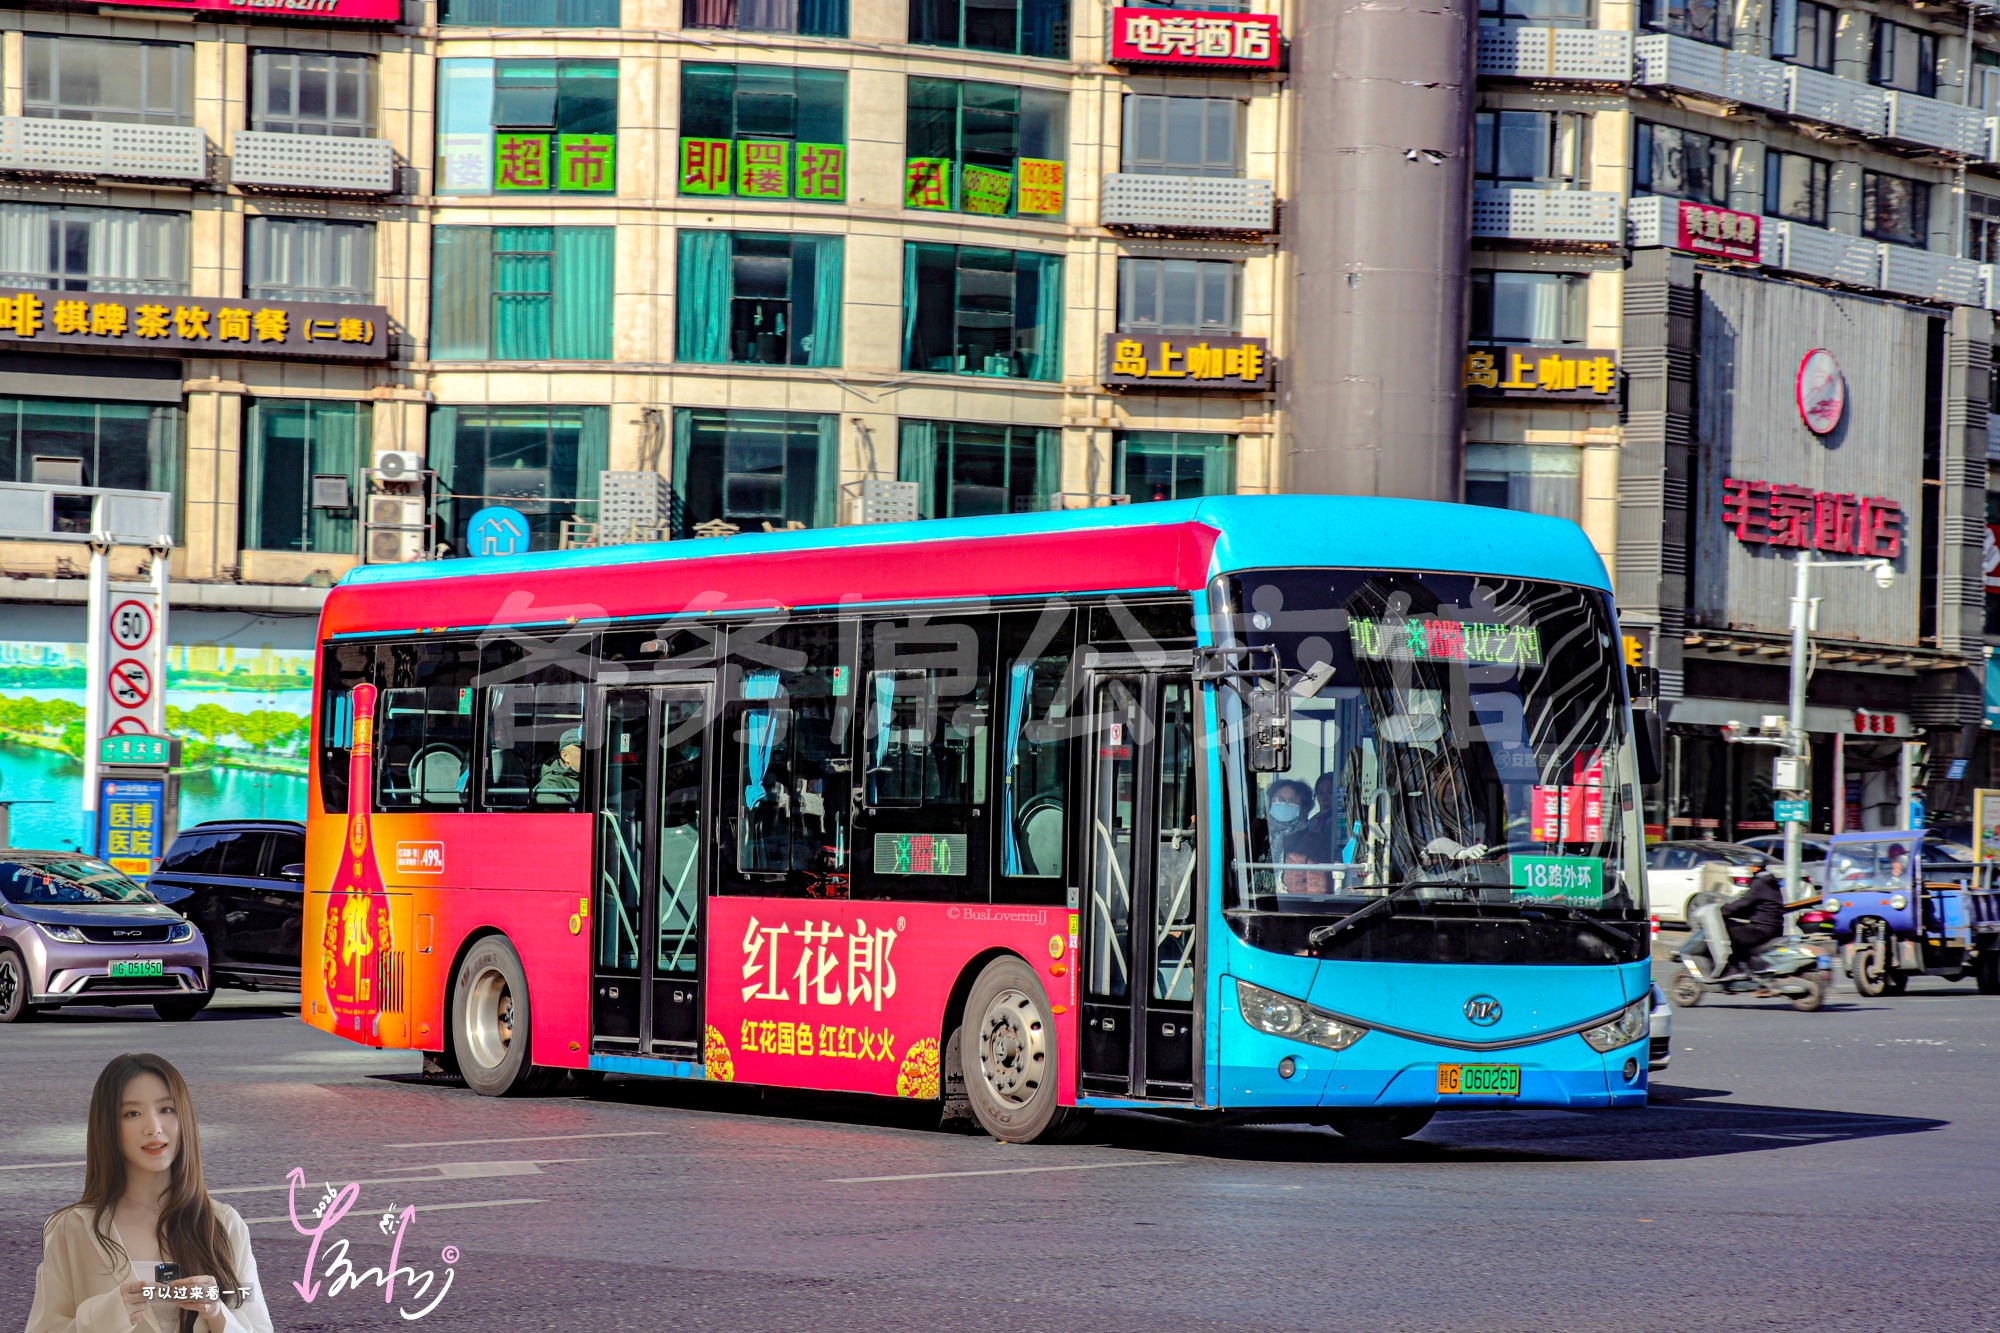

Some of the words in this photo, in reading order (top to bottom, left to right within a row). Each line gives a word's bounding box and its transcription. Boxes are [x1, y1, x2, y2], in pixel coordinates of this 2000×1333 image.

[1124, 15, 1271, 60] 电竞酒店
[500, 136, 609, 189] 超市
[53, 300, 128, 336] 棋牌
[135, 305, 209, 339] 茶饮
[217, 307, 289, 343] 简餐
[1112, 338, 1264, 381] 岛上咖啡
[1463, 350, 1616, 394] 岛上咖啡
[120, 612, 142, 639] 50
[108, 829, 152, 855] 医院
[1523, 864, 1592, 889] 18路外环
[741, 915, 898, 1012] 红花郎
[741, 1018, 815, 1056] 红花国色
[818, 1023, 896, 1063] 红红火火
